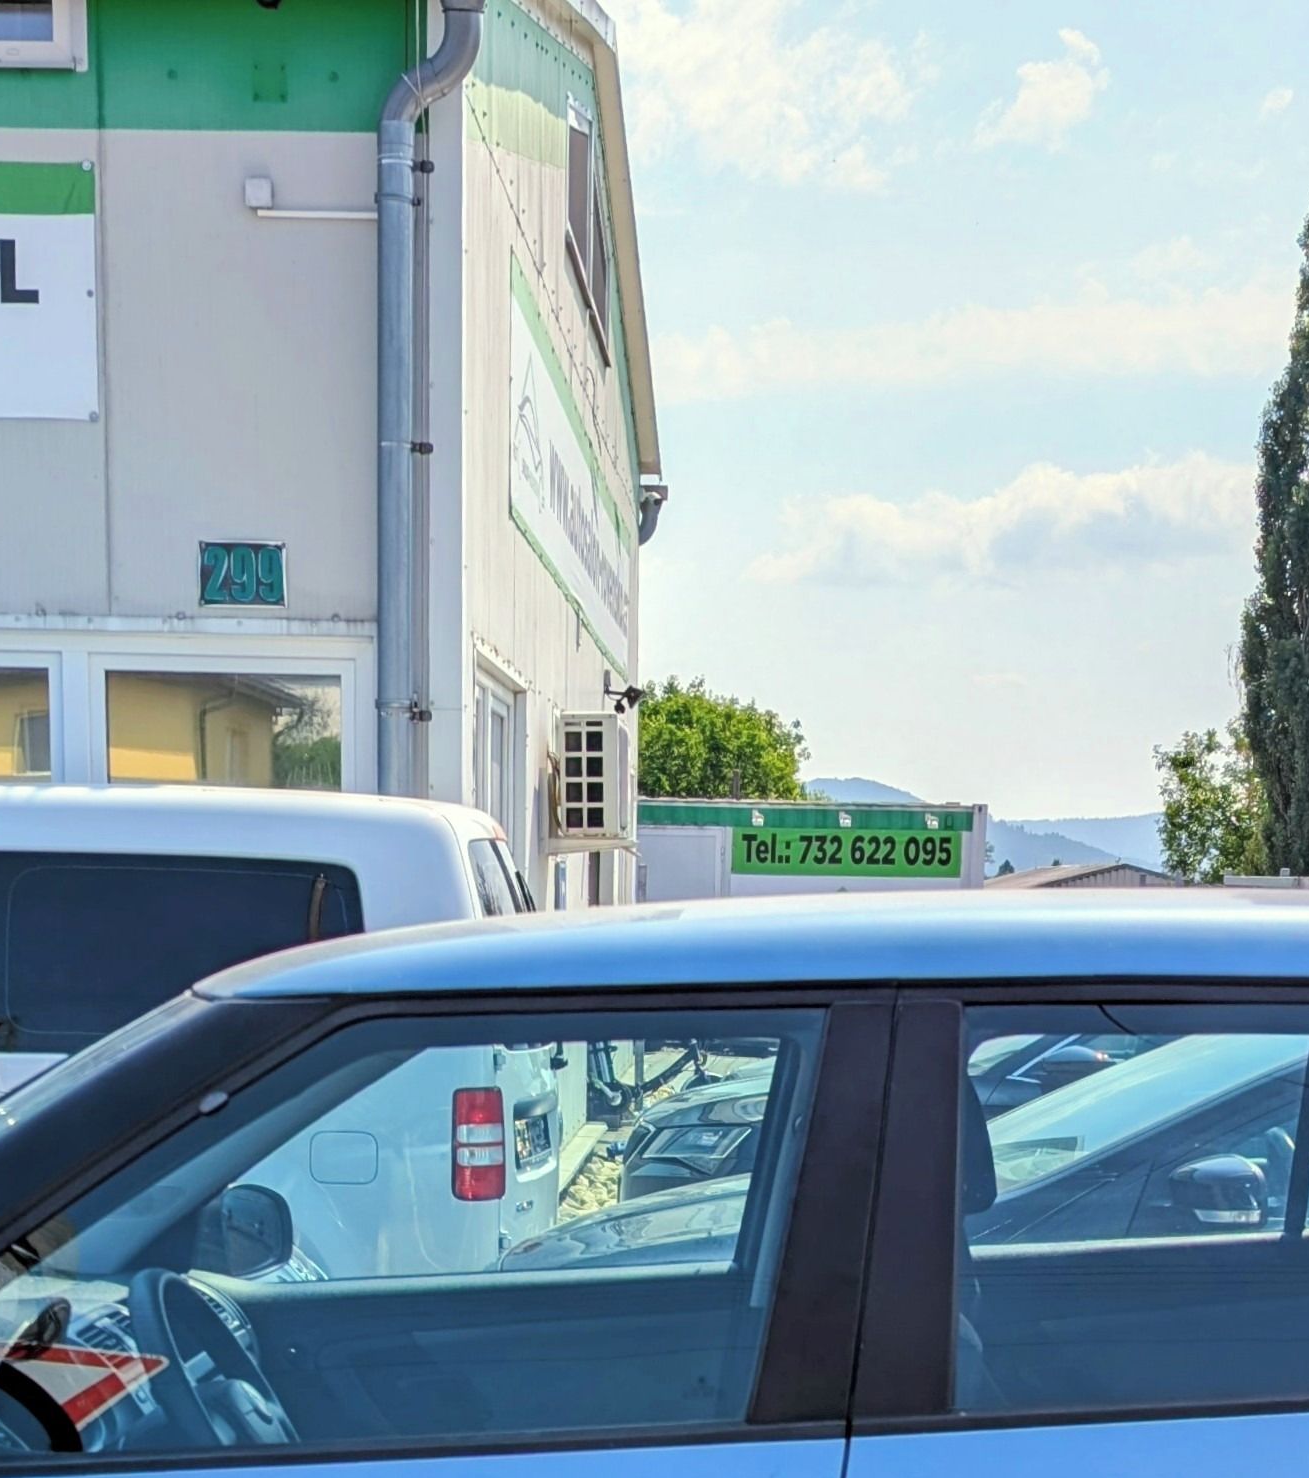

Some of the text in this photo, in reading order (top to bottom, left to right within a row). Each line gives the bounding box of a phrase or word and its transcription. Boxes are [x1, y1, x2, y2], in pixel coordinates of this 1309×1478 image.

[203, 546, 283, 602] 299
[742, 833, 953, 866] Tel.: 732 622 095
